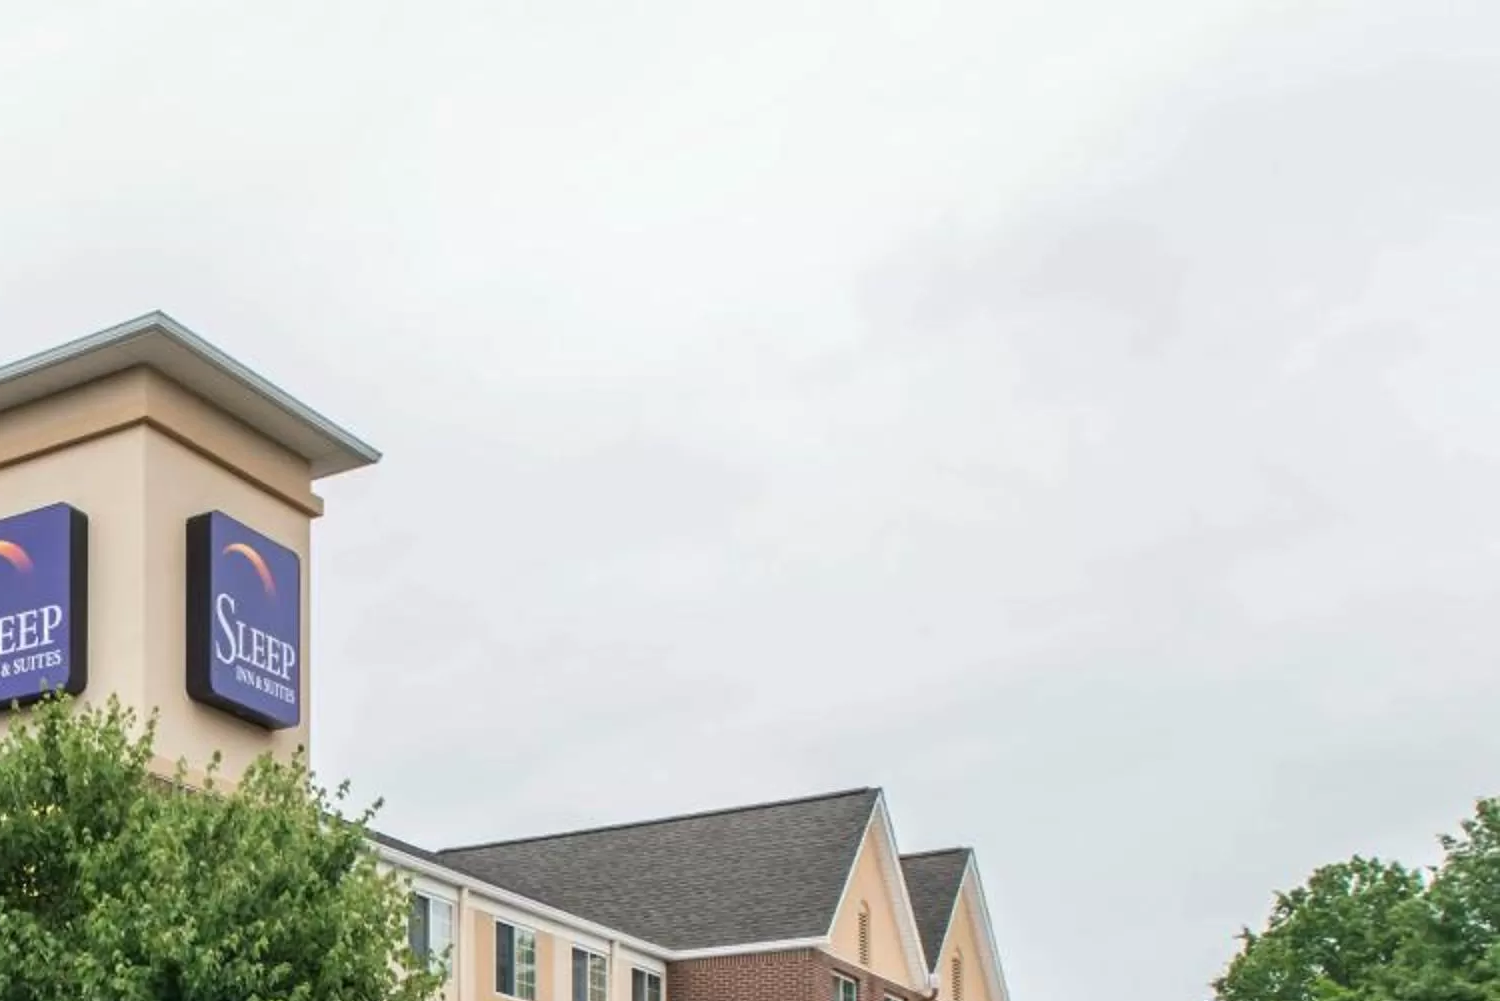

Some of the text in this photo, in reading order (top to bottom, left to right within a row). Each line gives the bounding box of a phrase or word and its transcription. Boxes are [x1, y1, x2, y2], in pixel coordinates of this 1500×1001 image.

[1, 662, 11, 678] &
[13, 649, 61, 675] SUITES
[216, 593, 296, 681] SLEEP
